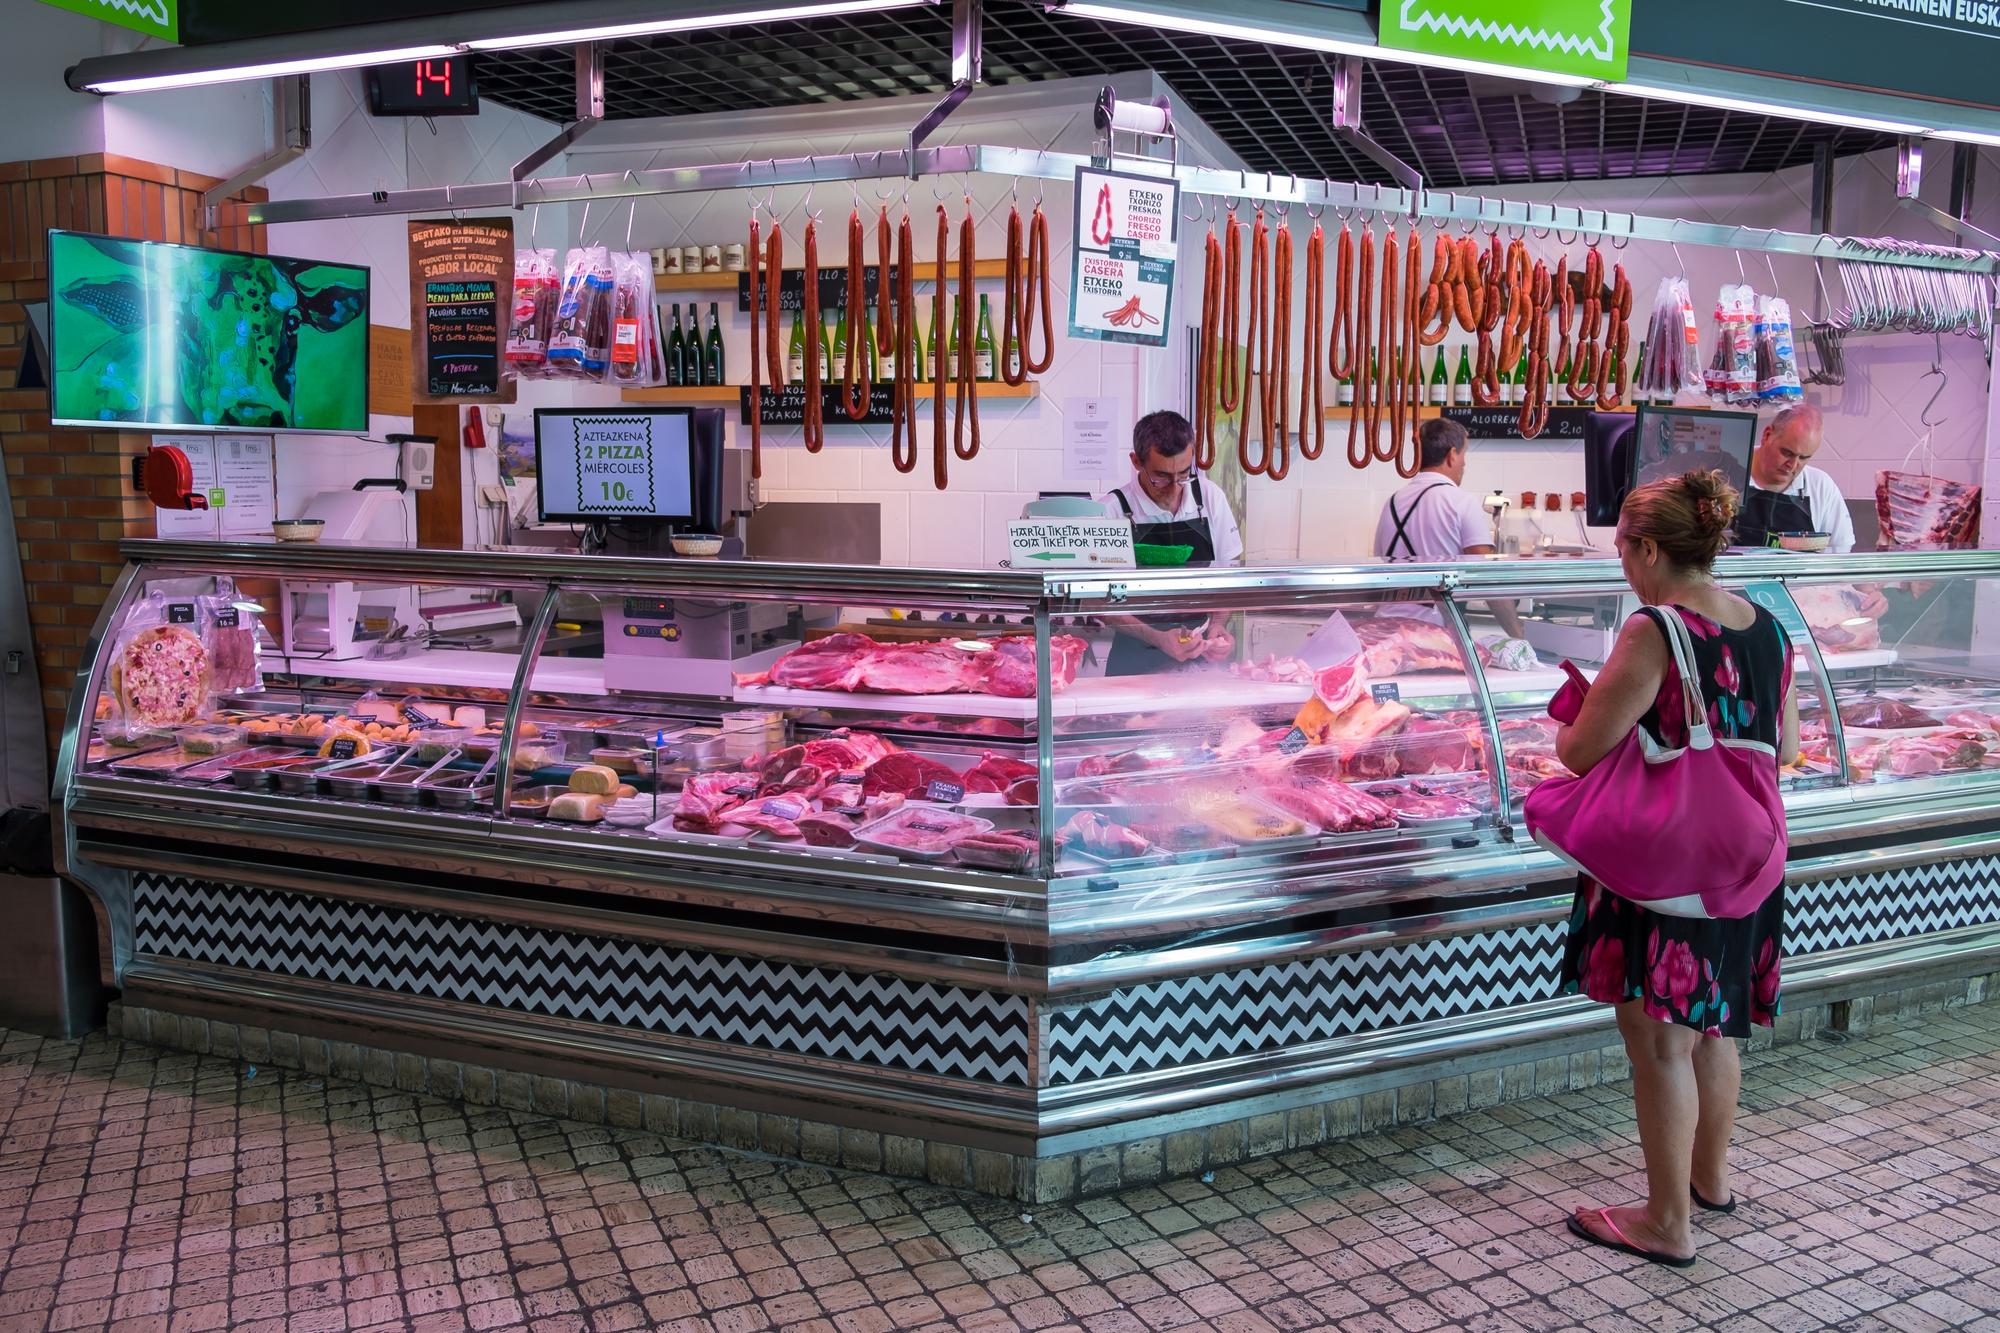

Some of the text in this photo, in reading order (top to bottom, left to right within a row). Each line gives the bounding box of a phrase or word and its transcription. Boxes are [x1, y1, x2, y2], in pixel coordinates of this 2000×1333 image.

[1955, 1, 2000, 28] EUSK
[416, 60, 450, 96] 14
[1129, 189, 1163, 201] ETXEKO
[1129, 198, 1162, 208] TXORIZO
[1128, 204, 1162, 215] FRESKOA
[1128, 214, 1161, 224] CHORIZO
[1128, 222, 1161, 232] FRESCO
[412, 226, 451, 242] BERTAKO
[463, 226, 508, 238] BENETAKO
[1127, 230, 1160, 240] CASERO
[424, 236, 497, 248] ZAPOREA DUTEN JAKIAK
[418, 254, 452, 266] PRODUCTOS
[468, 254, 504, 264] VERDADERO
[1084, 258, 1124, 268] TXISTORRA
[424, 261, 497, 277] SABOR LOCAL
[1084, 264, 1124, 278] CASERA
[1083, 276, 1122, 289] ETXEKO
[1083, 286, 1122, 297] TXISTORRA
[428, 294, 450, 302] MENU
[451, 293, 468, 302] PARA
[461, 307, 489, 316] ROJAS
[762, 410, 802, 420] TXAKOL
[1560, 421, 1582, 434] 2,10
[583, 432, 644, 442] AZTEAZKENA
[584, 446, 645, 459] 2 PIZZA
[584, 460, 644, 474] MIÉRCOLES
[1010, 526, 1128, 537] HARTU TIKETA MESEDEZ
[1013, 537, 1128, 548] COJA TIKET POR FAVOR
